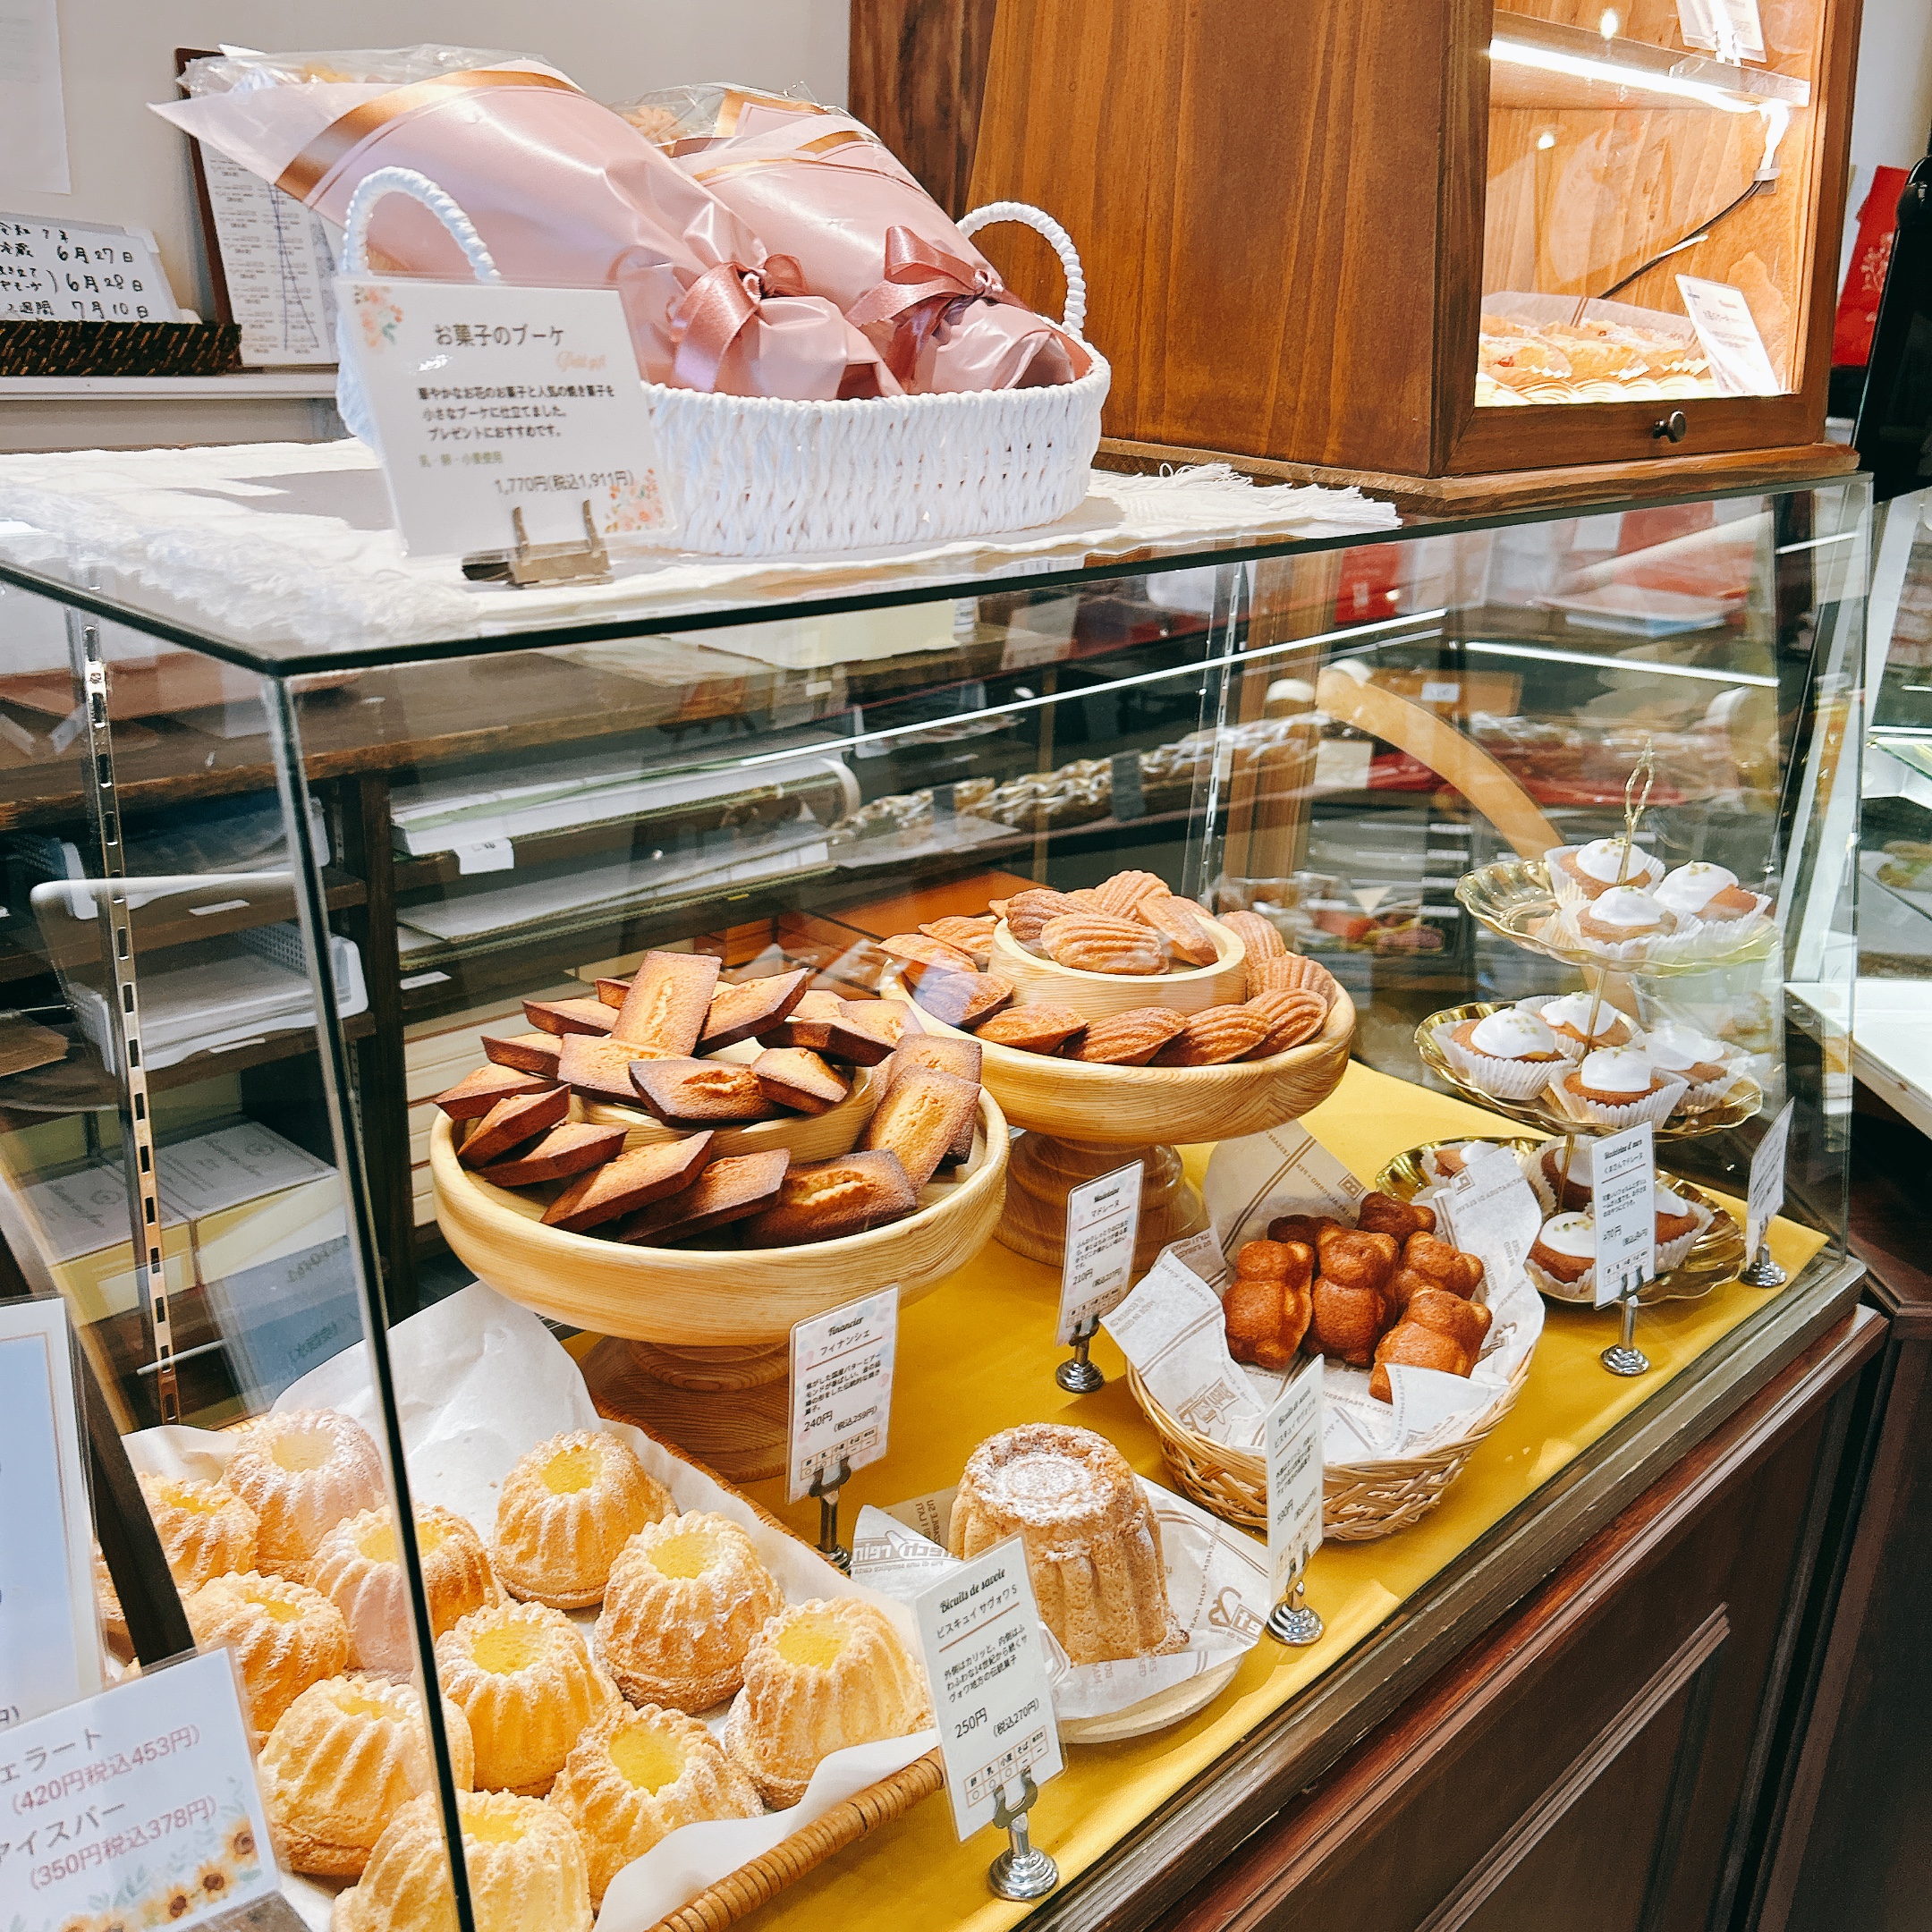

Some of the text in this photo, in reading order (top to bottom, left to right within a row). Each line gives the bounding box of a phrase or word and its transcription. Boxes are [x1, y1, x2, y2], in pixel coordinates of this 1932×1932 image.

[435, 324, 564, 347] お菓子のブーケ
[820, 1329, 869, 1356] フィナンシェ
[803, 1410, 833, 1432] 240円
[970, 1584, 979, 1597] de
[981, 1569, 1004, 1589] savoie
[936, 1607, 976, 1640] ビスキュイ
[979, 1589, 1009, 1614] サヴォワ
[945, 1624, 1025, 1681] 外側はカリッと、内側はふ
[947, 1635, 1027, 1690] わふわな14世紀から続くサ
[949, 1654, 1017, 1703] ヴォワ地方の伝統菓子
[954, 1707, 987, 1739] 250円
[993, 1698, 1038, 1737] (税込270円)
[12, 1723, 201, 1816] (420円税込453円)
[30, 1795, 217, 1891] (350円税込378円)
